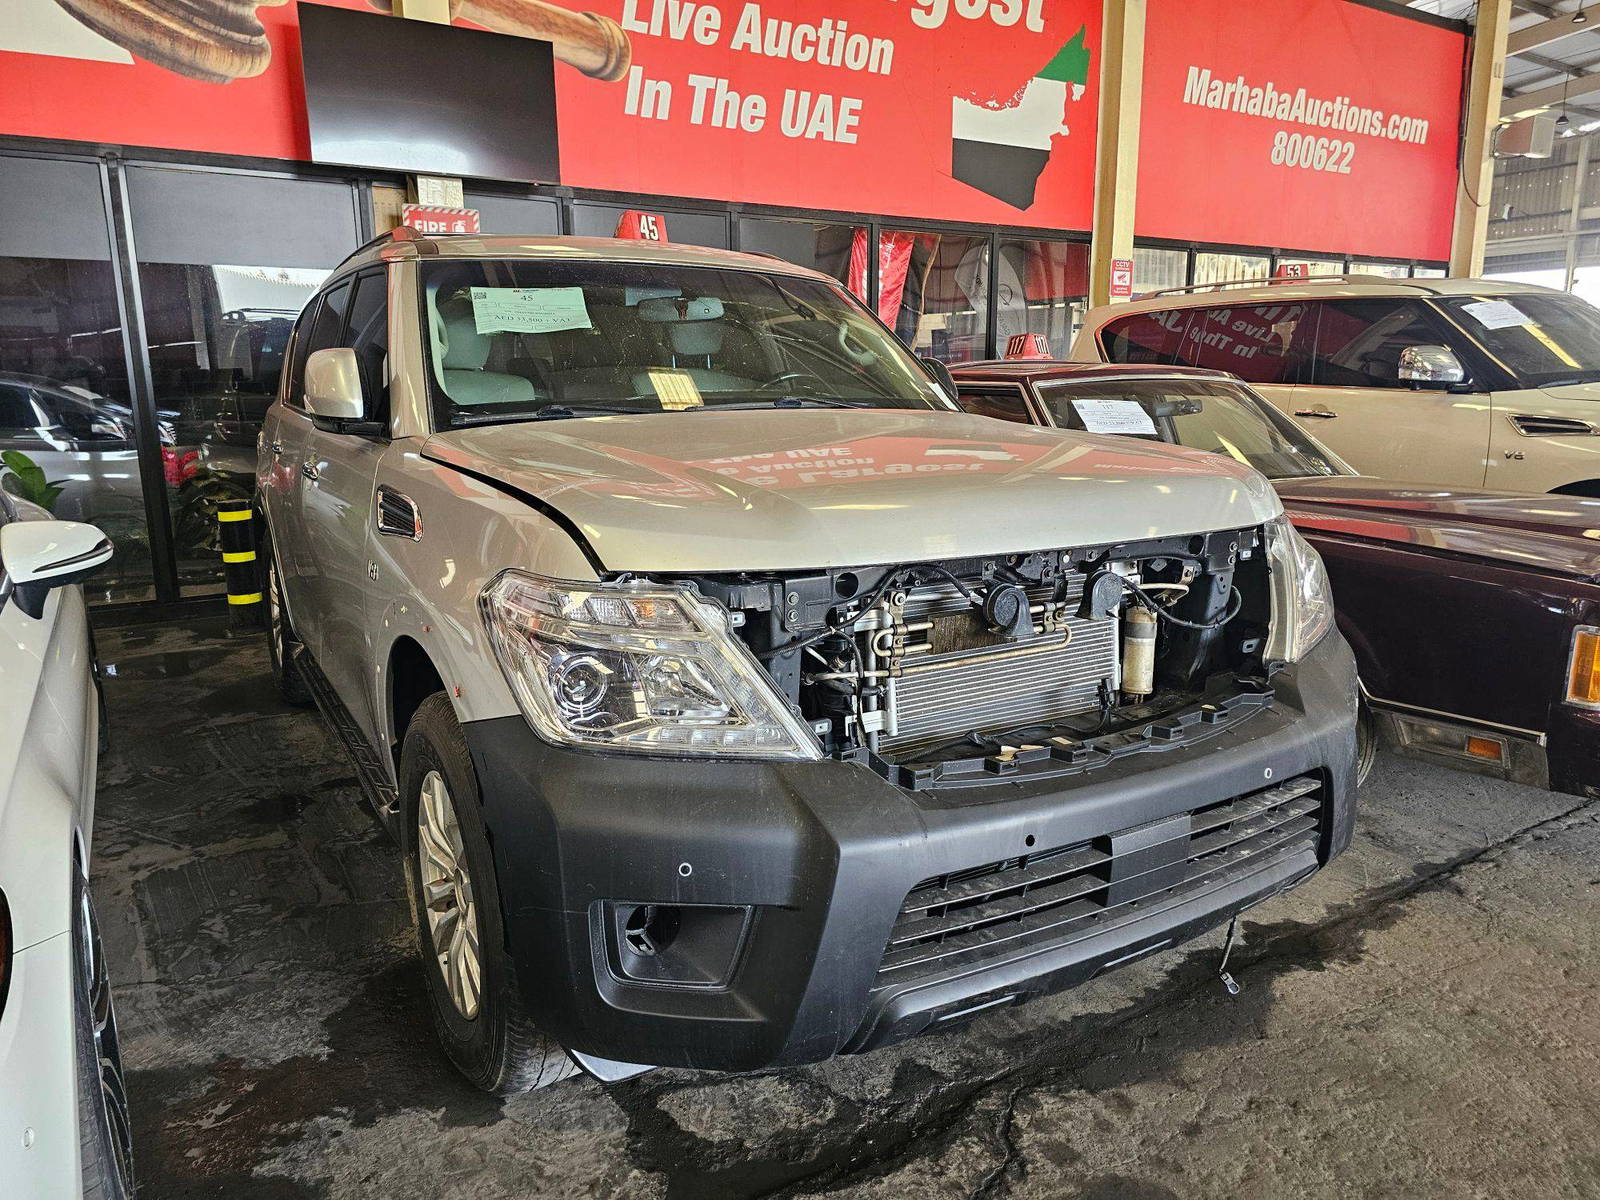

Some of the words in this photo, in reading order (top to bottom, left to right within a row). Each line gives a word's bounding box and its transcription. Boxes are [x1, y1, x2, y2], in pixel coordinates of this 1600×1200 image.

[621, 0, 722, 46] Live
[730, 2, 895, 75] Auction
[624, 65, 672, 121] In
[688, 73, 767, 133] The
[780, 88, 863, 144] UAE
[1183, 66, 1429, 145] MarhabaAuctions.com
[1271, 131, 1356, 174] 800622
[640, 215, 659, 241] 45
[1287, 264, 1301, 278] 53
